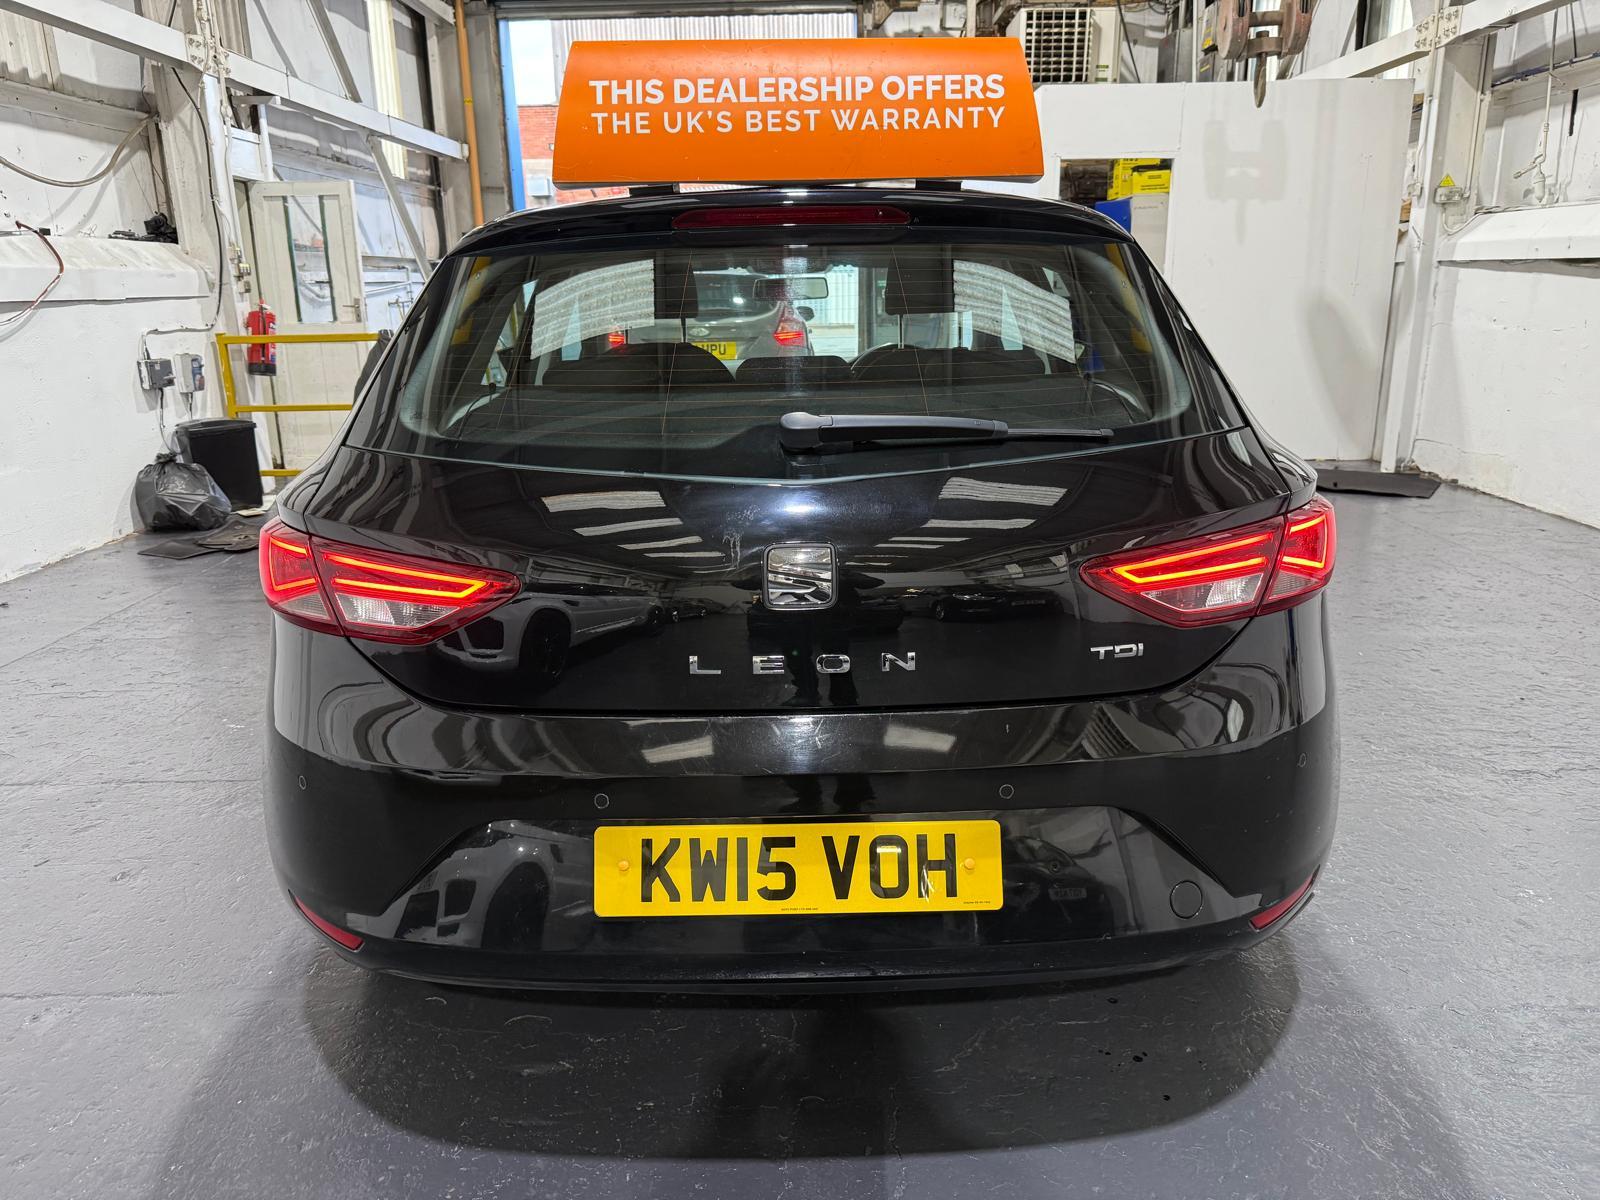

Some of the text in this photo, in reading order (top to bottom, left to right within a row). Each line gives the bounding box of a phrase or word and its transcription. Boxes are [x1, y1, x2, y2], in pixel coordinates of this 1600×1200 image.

[589, 74, 1005, 105] THIS DEALERSHIP OFFERS
[592, 106, 1005, 134] THE UK'S BEST WARRANTY
[689, 651, 916, 675] LEON
[1090, 642, 1145, 660] TDI
[641, 833, 958, 903] KW15 VOH
